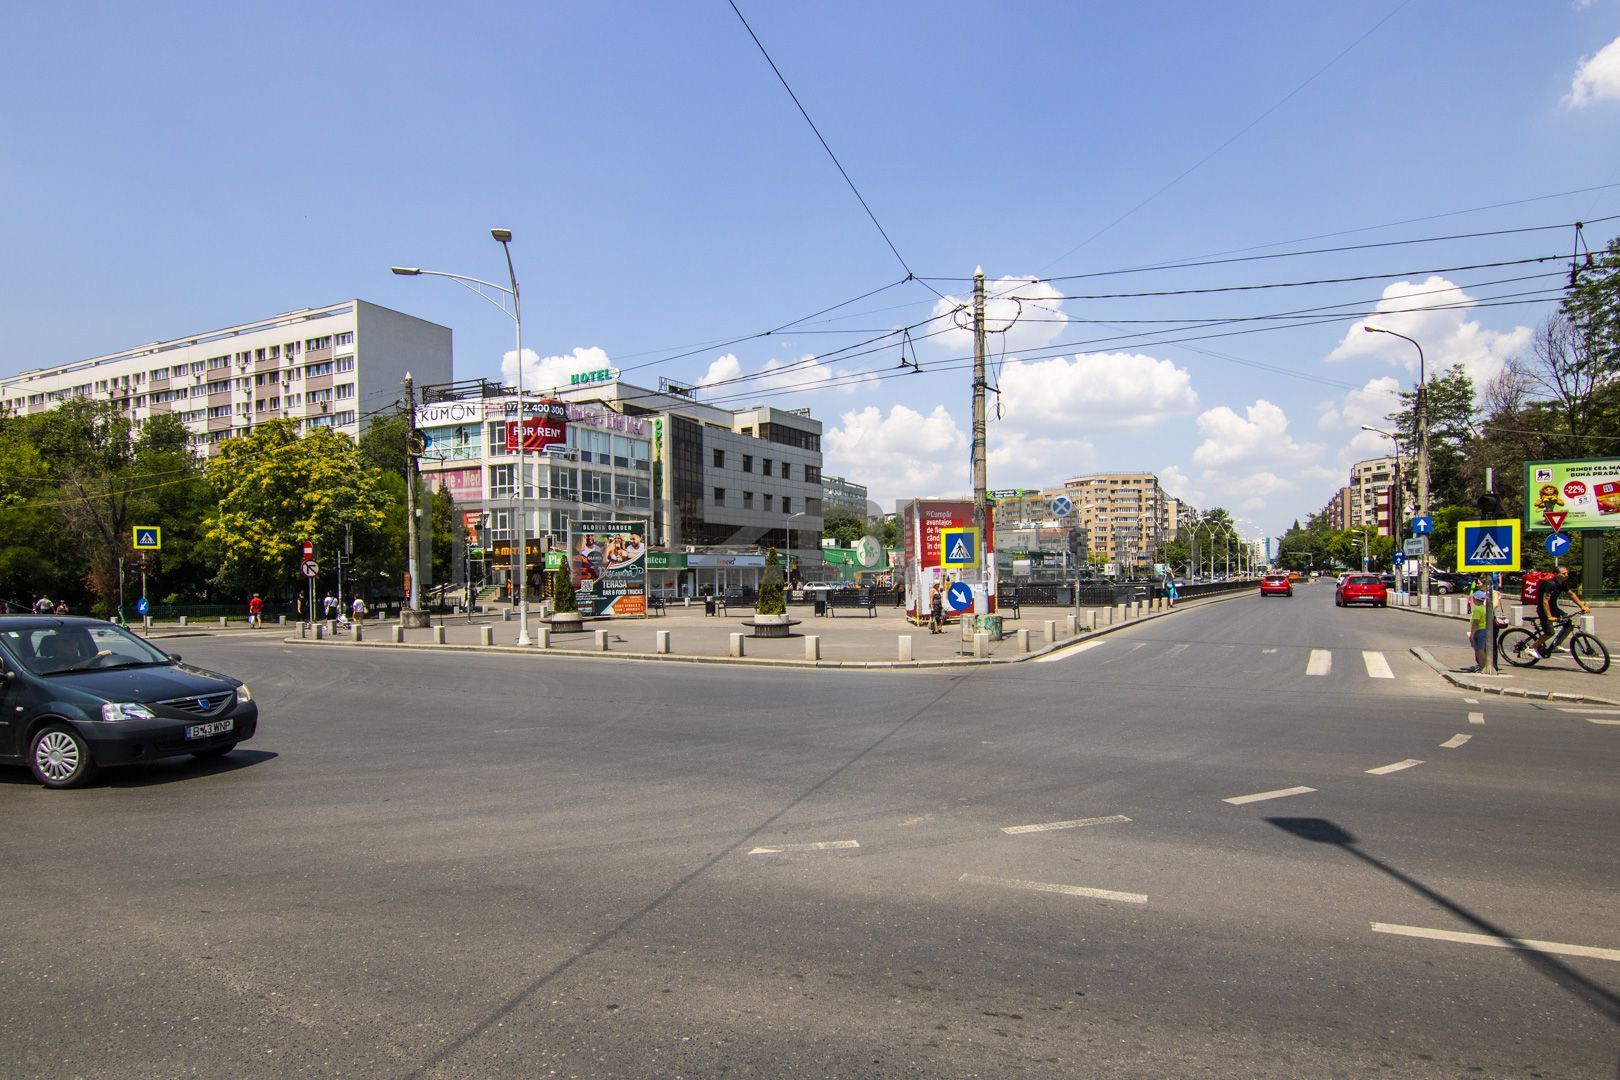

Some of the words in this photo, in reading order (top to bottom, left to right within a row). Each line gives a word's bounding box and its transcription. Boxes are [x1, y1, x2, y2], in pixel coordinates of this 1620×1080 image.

[570, 368, 612, 385] HOTEL
[421, 404, 475, 422] KUMON
[506, 402, 549, 413] 072.400
[551, 404, 564, 416] 300
[537, 427, 561, 438] RENT
[463, 469, 480, 488] Med
[1564, 484, 1585, 494] -22%
[926, 519, 952, 528] avantajos
[602, 580, 628, 589] TERASA
[193, 726, 200, 737] B
[214, 720, 231, 732] WNP
